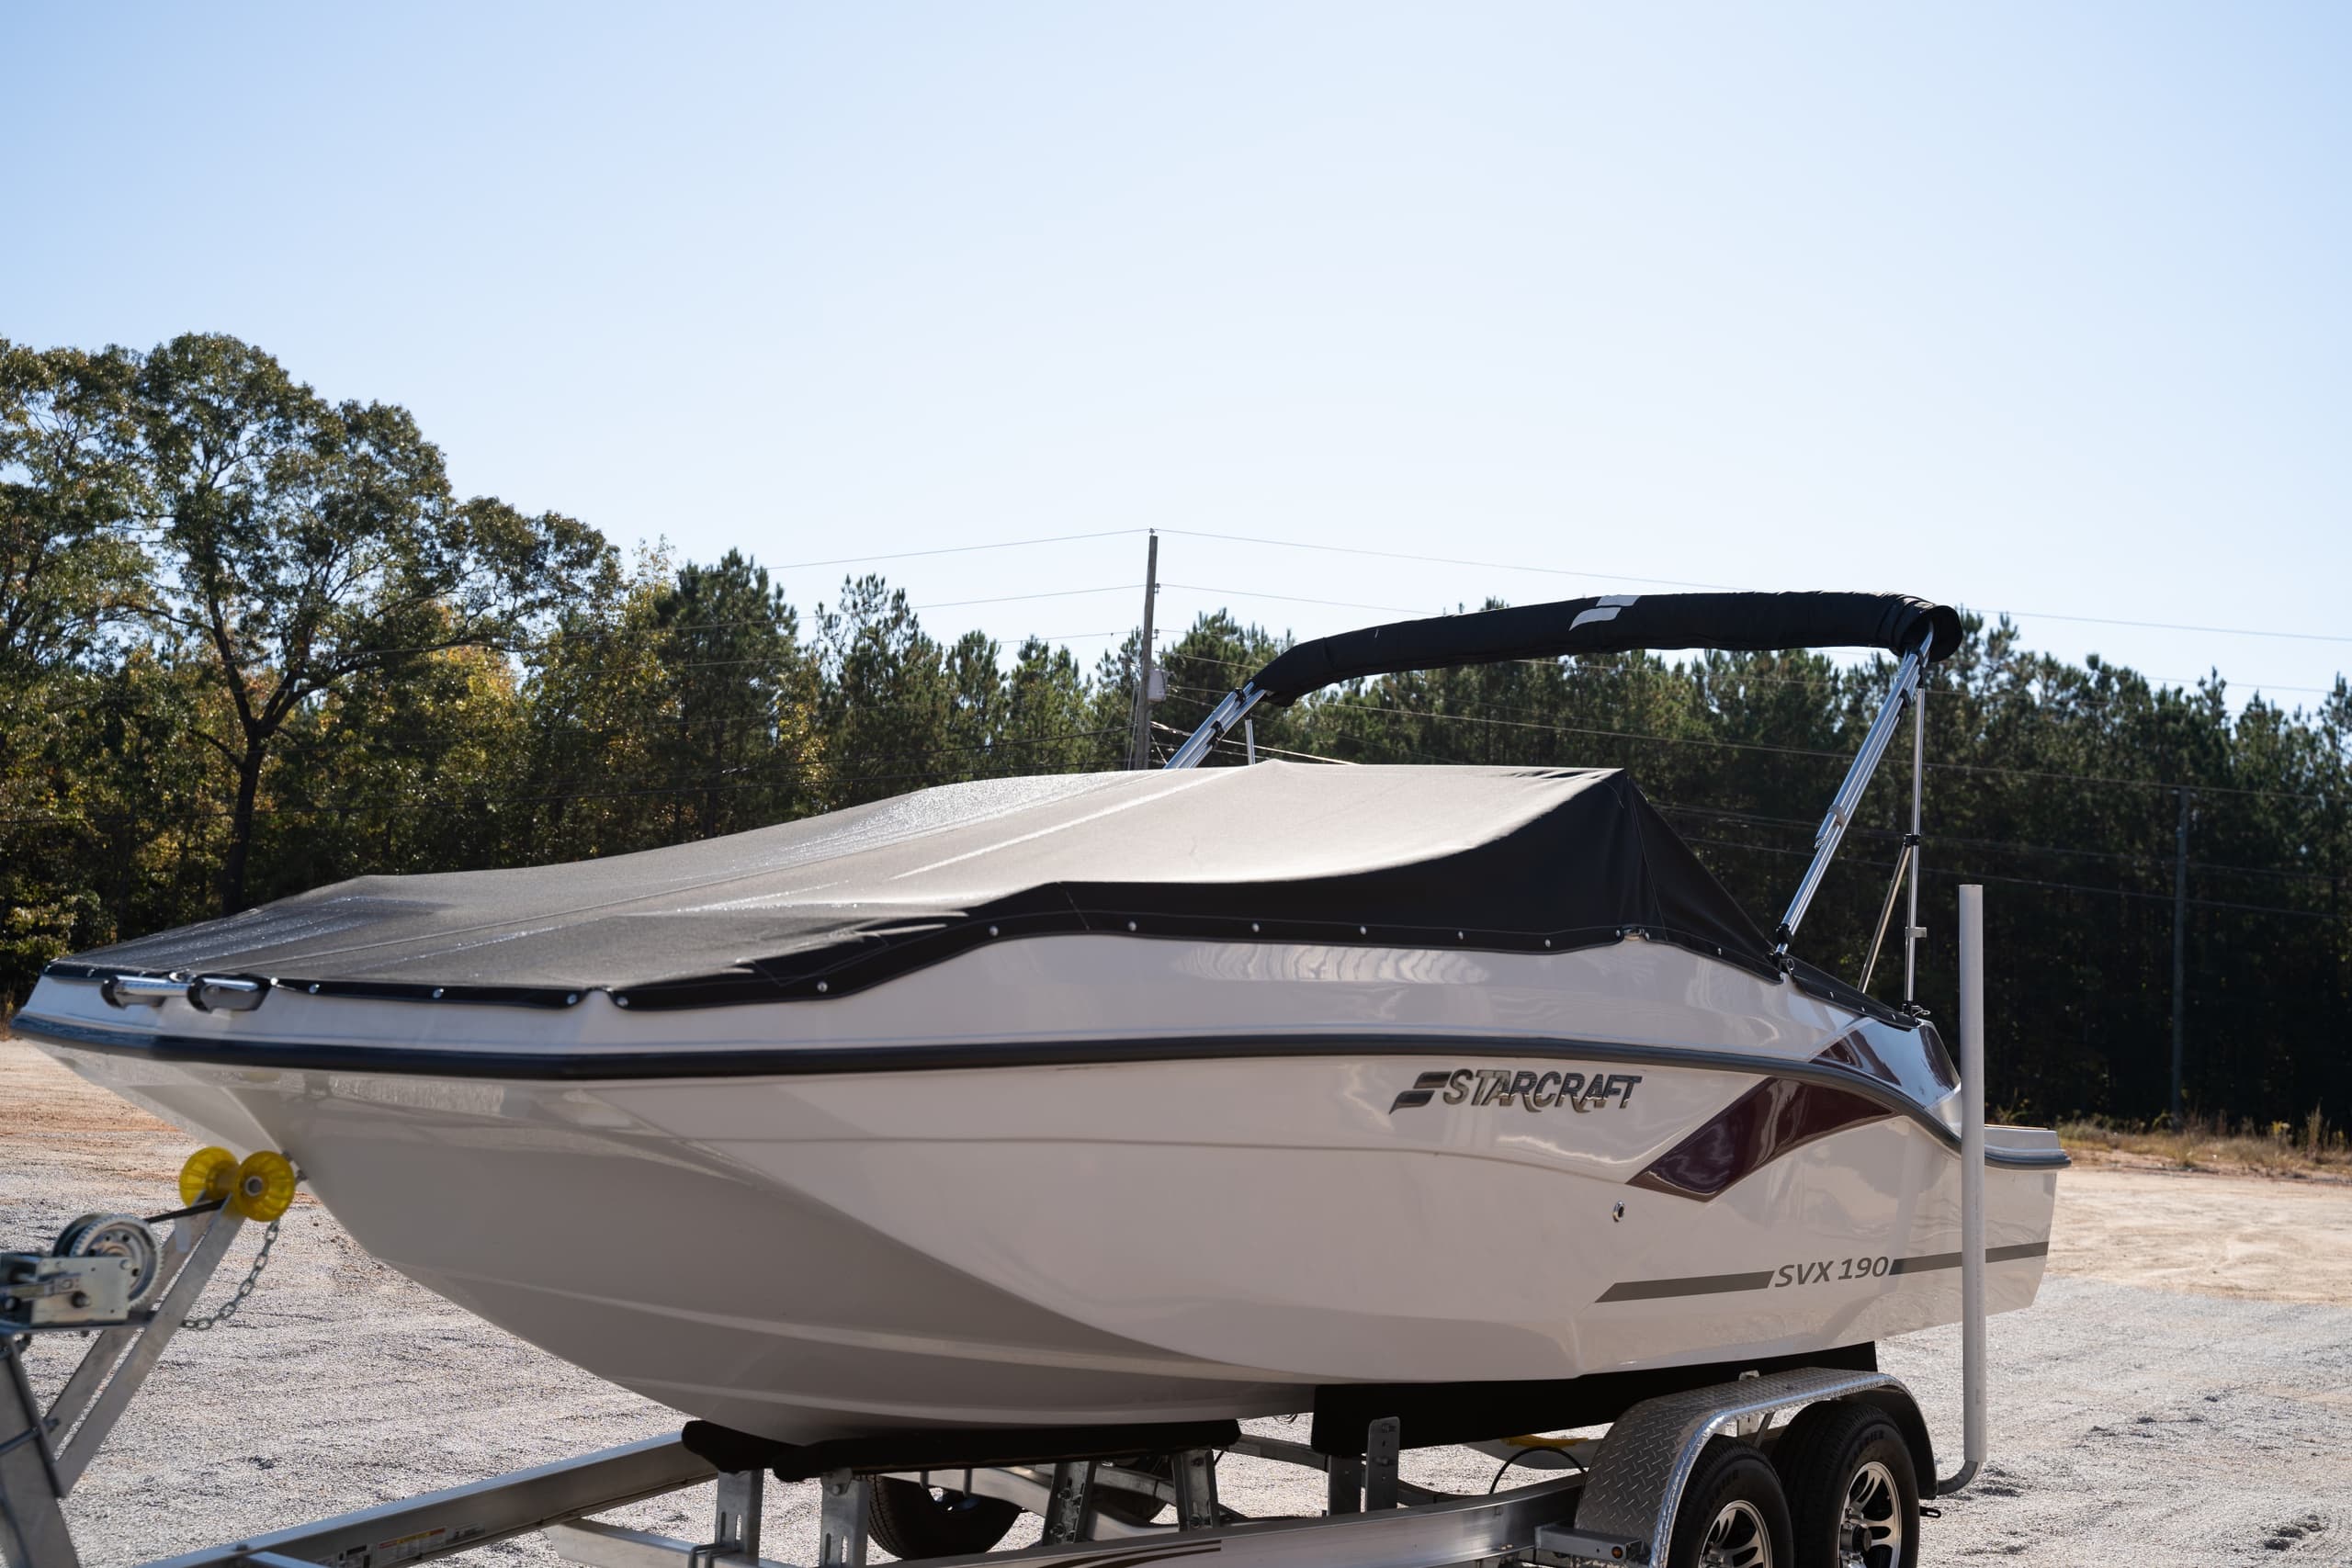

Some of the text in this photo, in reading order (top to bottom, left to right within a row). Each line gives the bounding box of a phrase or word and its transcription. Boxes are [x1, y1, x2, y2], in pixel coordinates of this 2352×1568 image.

[1442, 1068, 1643, 1112] STARCRAFT
[1774, 1256, 1889, 1288] SVX 190
